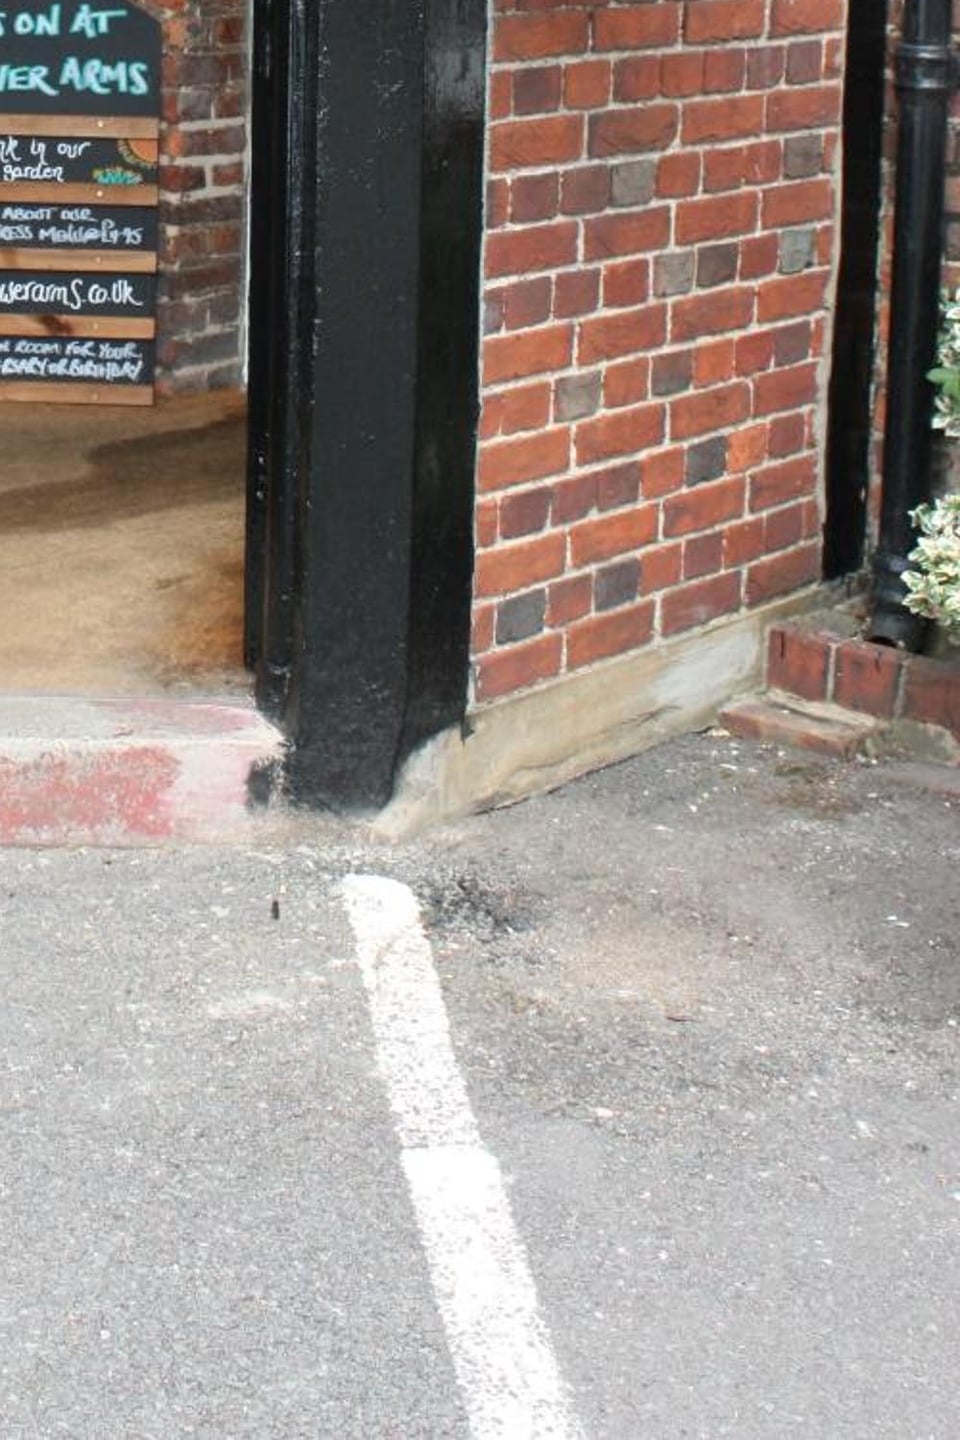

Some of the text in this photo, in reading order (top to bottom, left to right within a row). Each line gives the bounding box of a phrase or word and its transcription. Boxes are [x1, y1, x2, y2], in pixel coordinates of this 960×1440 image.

[13, 3, 61, 36] ON
[69, 3, 128, 39] AT
[58, 56, 149, 95] ARMS
[30, 137, 48, 164] in
[56, 139, 92, 159] our
[2, 161, 65, 182] garden
[1, 206, 57, 222] ABOUT
